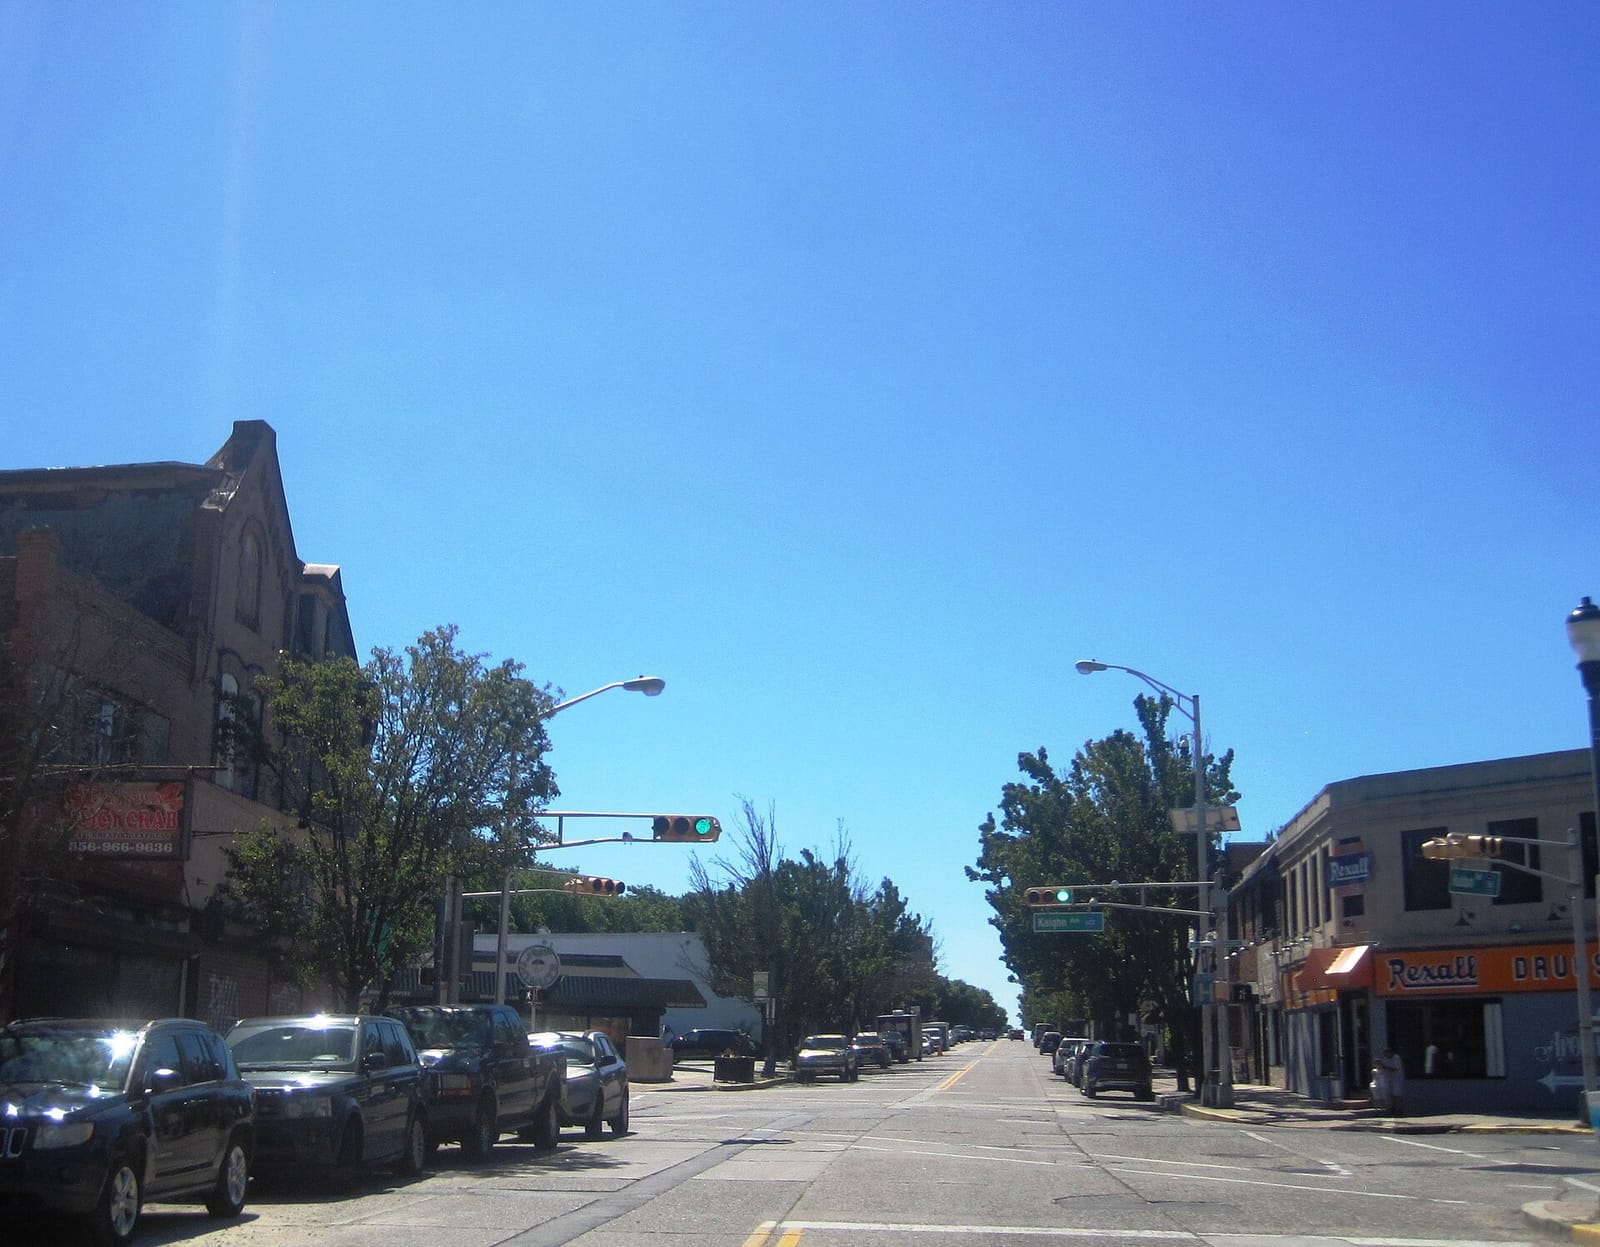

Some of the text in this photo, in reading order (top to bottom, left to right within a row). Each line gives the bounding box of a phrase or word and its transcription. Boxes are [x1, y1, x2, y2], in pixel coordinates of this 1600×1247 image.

[1331, 857, 1368, 881] Rexall
[1386, 953, 1600, 991] Rexall DRUS
